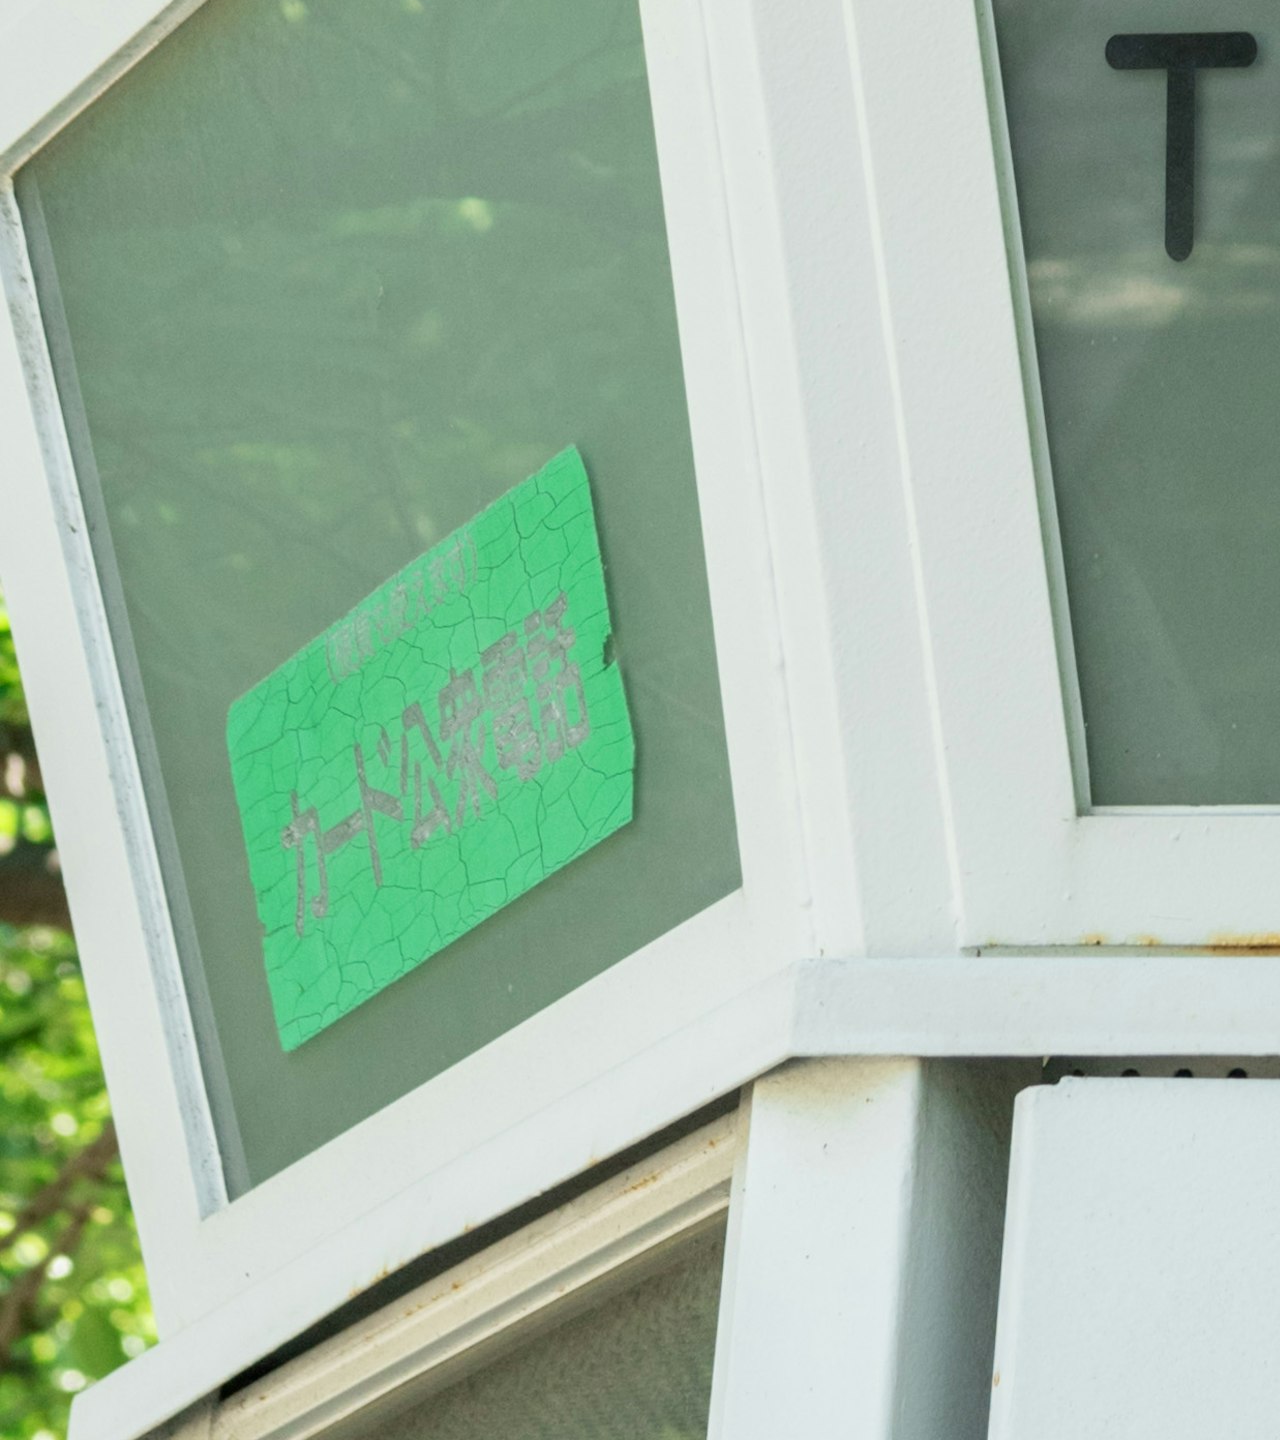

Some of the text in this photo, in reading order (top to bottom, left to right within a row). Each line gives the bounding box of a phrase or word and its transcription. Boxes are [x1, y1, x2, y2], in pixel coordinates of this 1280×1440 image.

[281, 590, 589, 938] カード公衆電話
